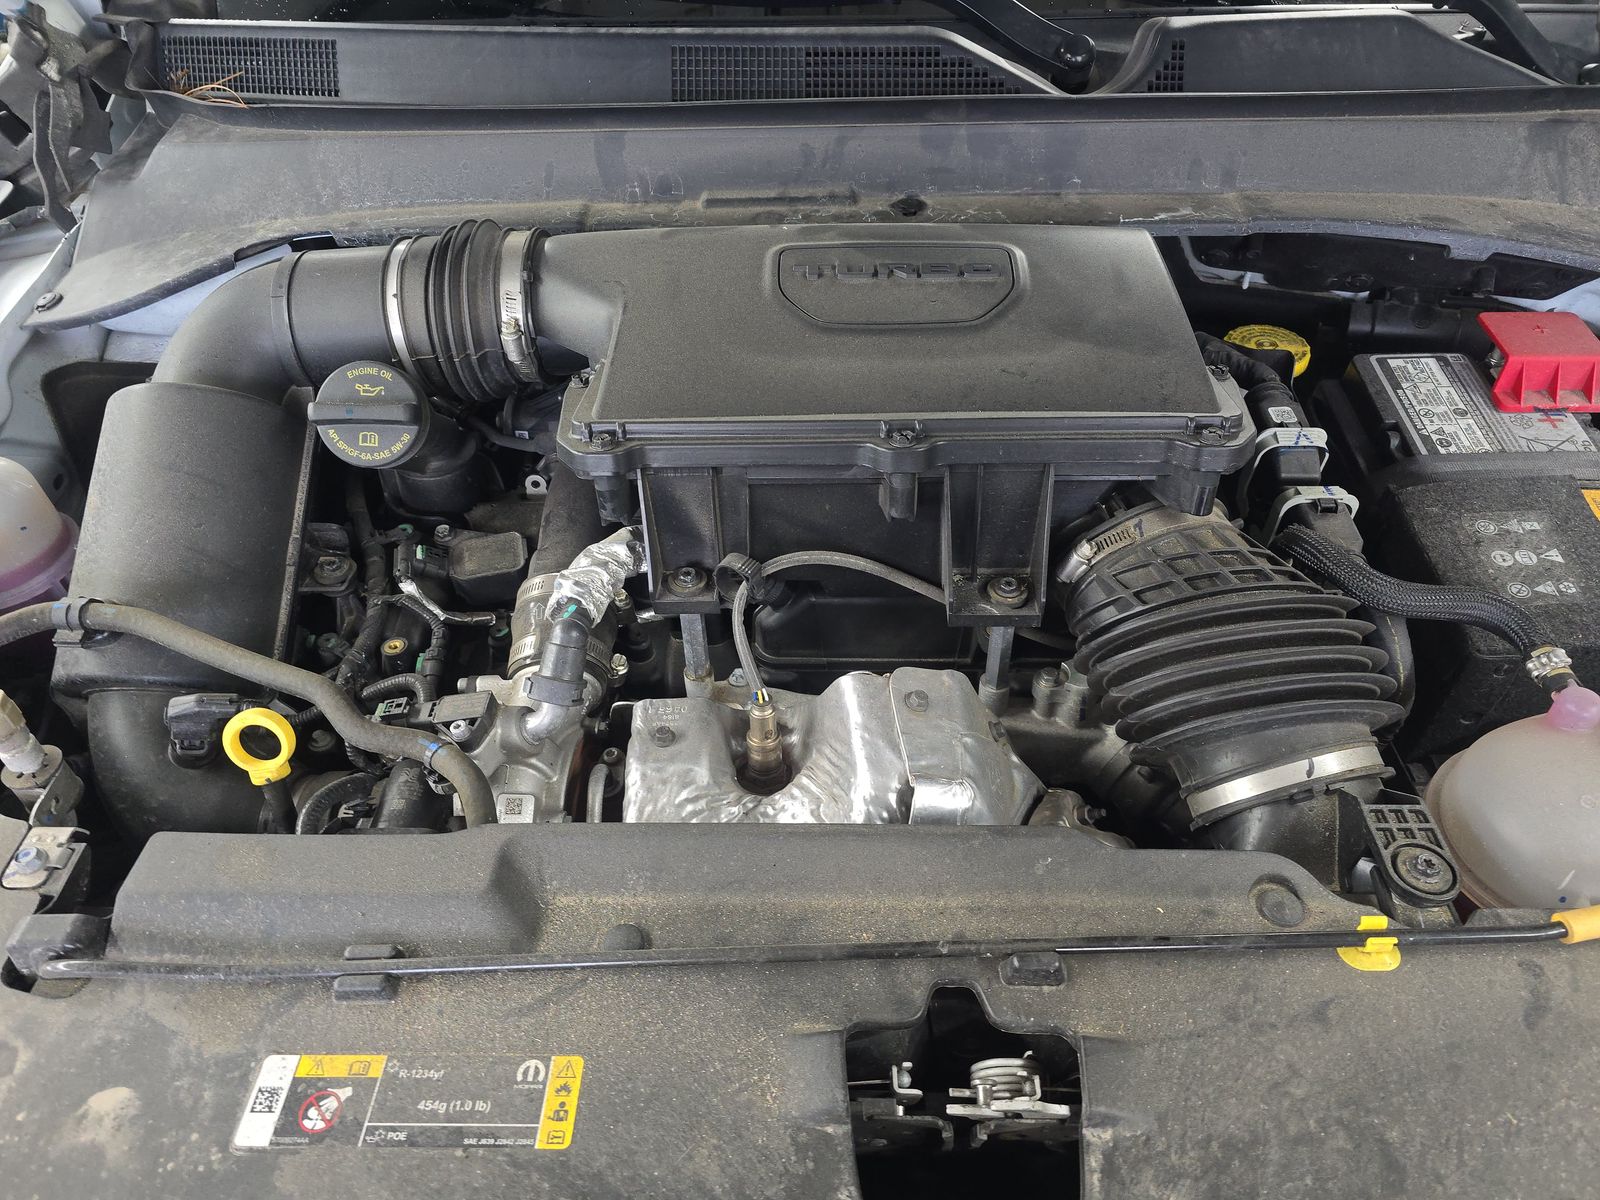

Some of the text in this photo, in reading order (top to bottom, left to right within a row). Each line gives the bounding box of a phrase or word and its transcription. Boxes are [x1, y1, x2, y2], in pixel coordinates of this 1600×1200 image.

[792, 262, 1001, 281] TURBO
[347, 367, 393, 382] ENGINE OIL
[328, 429, 339, 442] API
[392, 433, 410, 453] 5W-30
[399, 1069, 444, 1080] R-1234yf
[417, 1100, 491, 1113] 454g (1.0 lb)
[386, 1131, 408, 1141] POE
